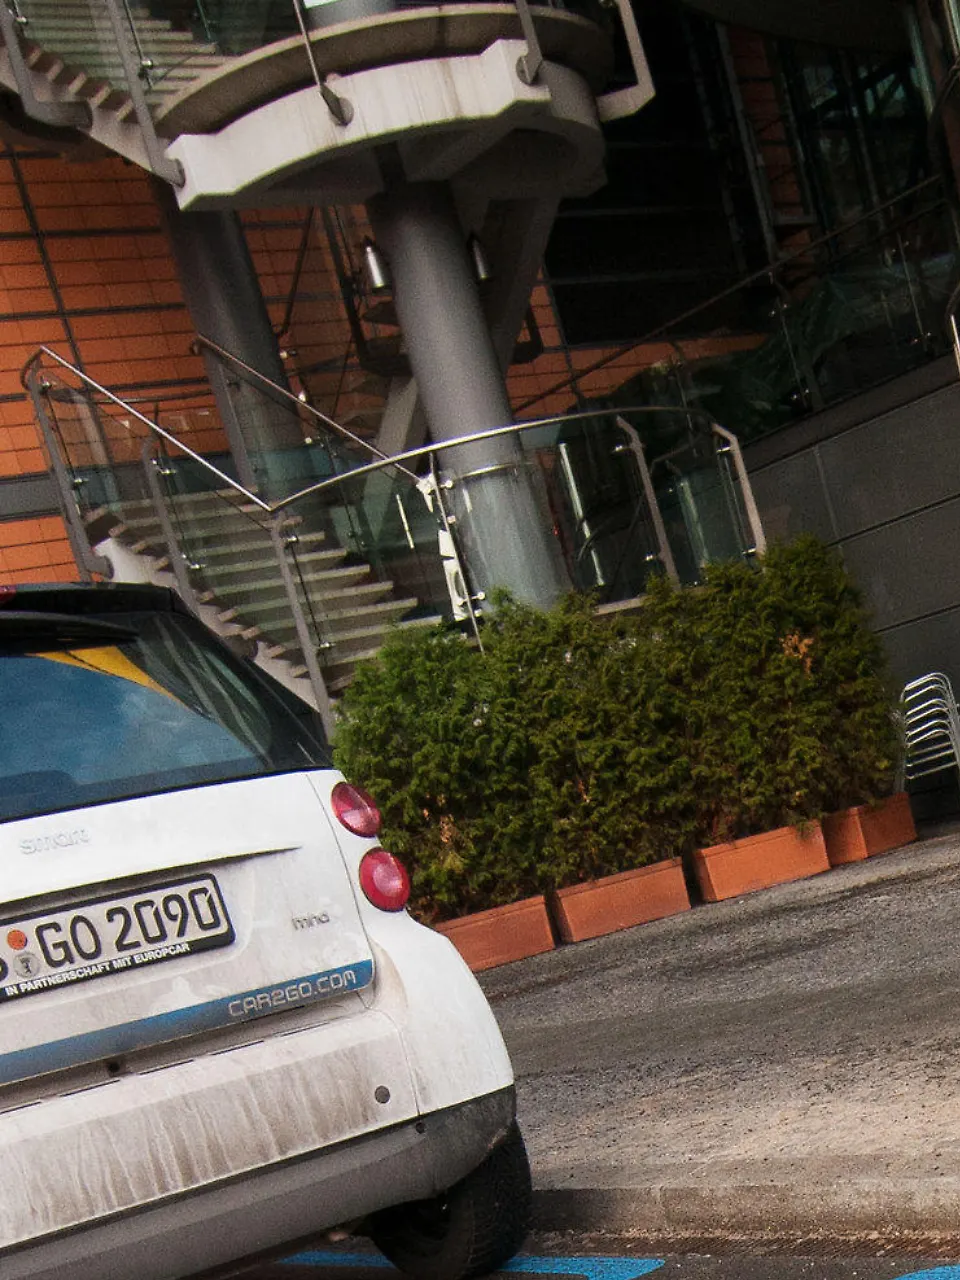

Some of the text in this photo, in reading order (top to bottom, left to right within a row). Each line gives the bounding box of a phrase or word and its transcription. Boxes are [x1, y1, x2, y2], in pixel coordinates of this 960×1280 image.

[35, 887, 221, 968] GO 2090
[4, 981, 19, 996] IN
[20, 961, 112, 993] PARTNERSCHAFT
[112, 954, 133, 970] MIT
[134, 942, 192, 964] EUROPCAR
[228, 969, 358, 1018] CAR2GO.COM
